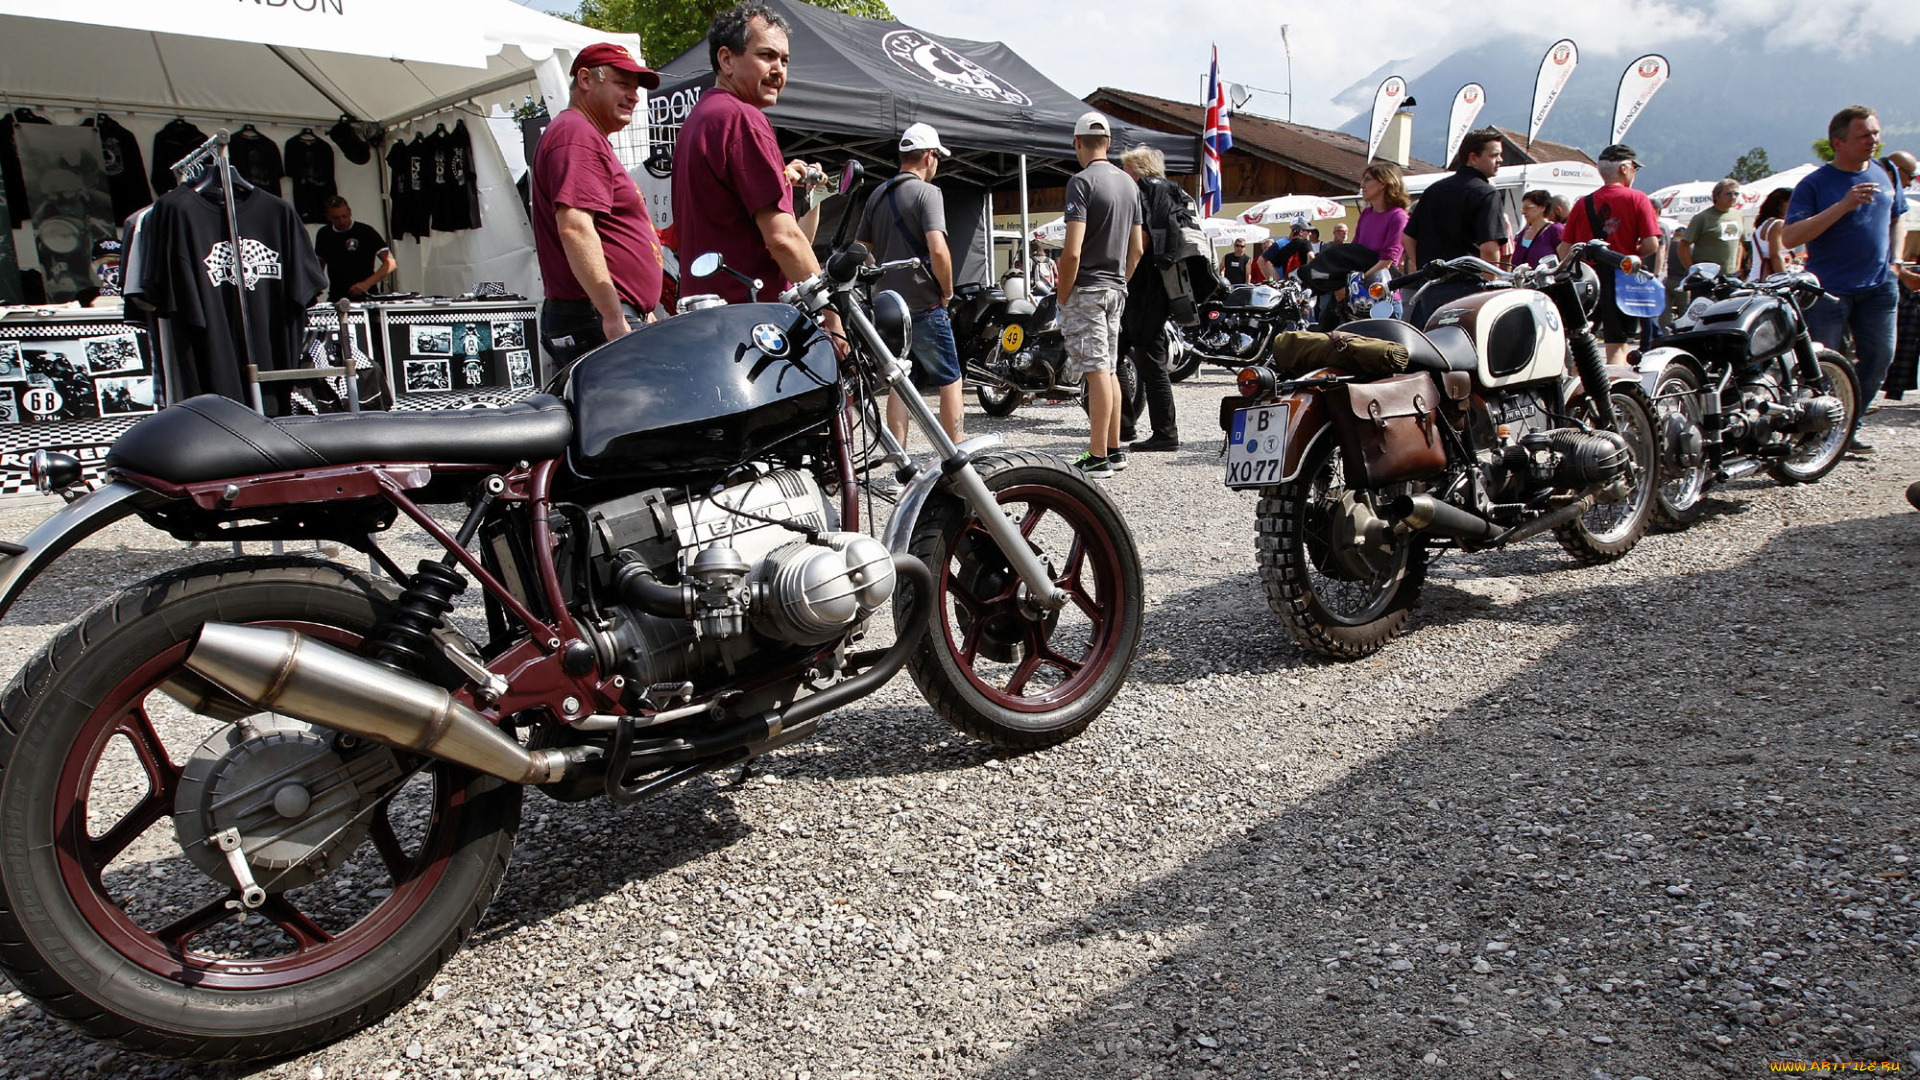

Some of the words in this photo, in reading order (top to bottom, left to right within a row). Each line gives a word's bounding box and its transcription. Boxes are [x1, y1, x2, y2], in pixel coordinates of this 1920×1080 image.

[891, 35, 920, 62] ACE
[1533, 89, 1557, 126] ERDINGER
[1616, 100, 1644, 135] ERDINGER
[1275, 210, 1305, 219] ERDINGER
[1006, 331, 1018, 345] 49
[31, 392, 55, 411] 68
[1258, 410, 1270, 432] B
[1235, 431, 1241, 441] D
